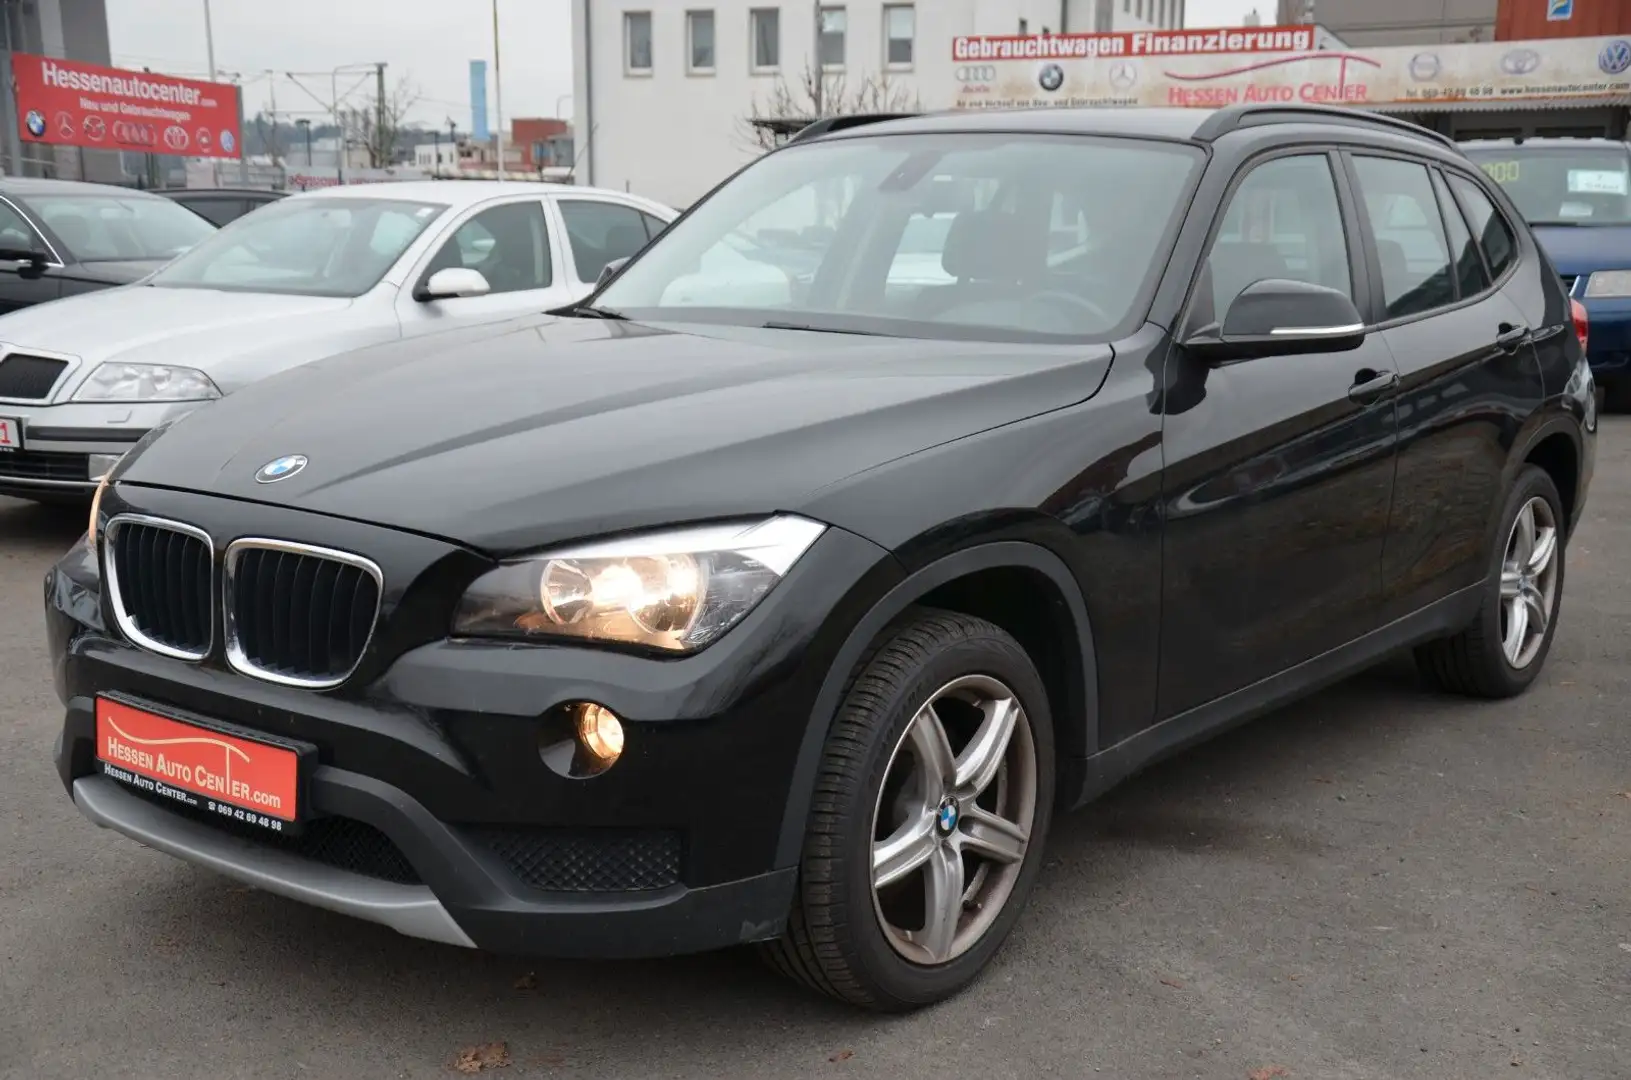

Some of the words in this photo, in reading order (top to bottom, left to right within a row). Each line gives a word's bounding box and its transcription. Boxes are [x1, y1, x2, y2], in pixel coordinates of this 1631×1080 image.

[955, 35, 1124, 58] Gebrauchtwagen
[1131, 30, 1311, 54] Finanzierung
[1168, 87, 1238, 105] HESSEN
[1243, 84, 1294, 102] AUTO
[107, 736, 153, 770] HESSEN
[156, 753, 192, 783] AUTO
[104, 763, 132, 783] HESSEN
[133, 774, 154, 791] AUTO
[217, 804, 233, 817] 069
[234, 809, 245, 820] 42
[258, 816, 270, 828] 48
[271, 820, 282, 832] 98
